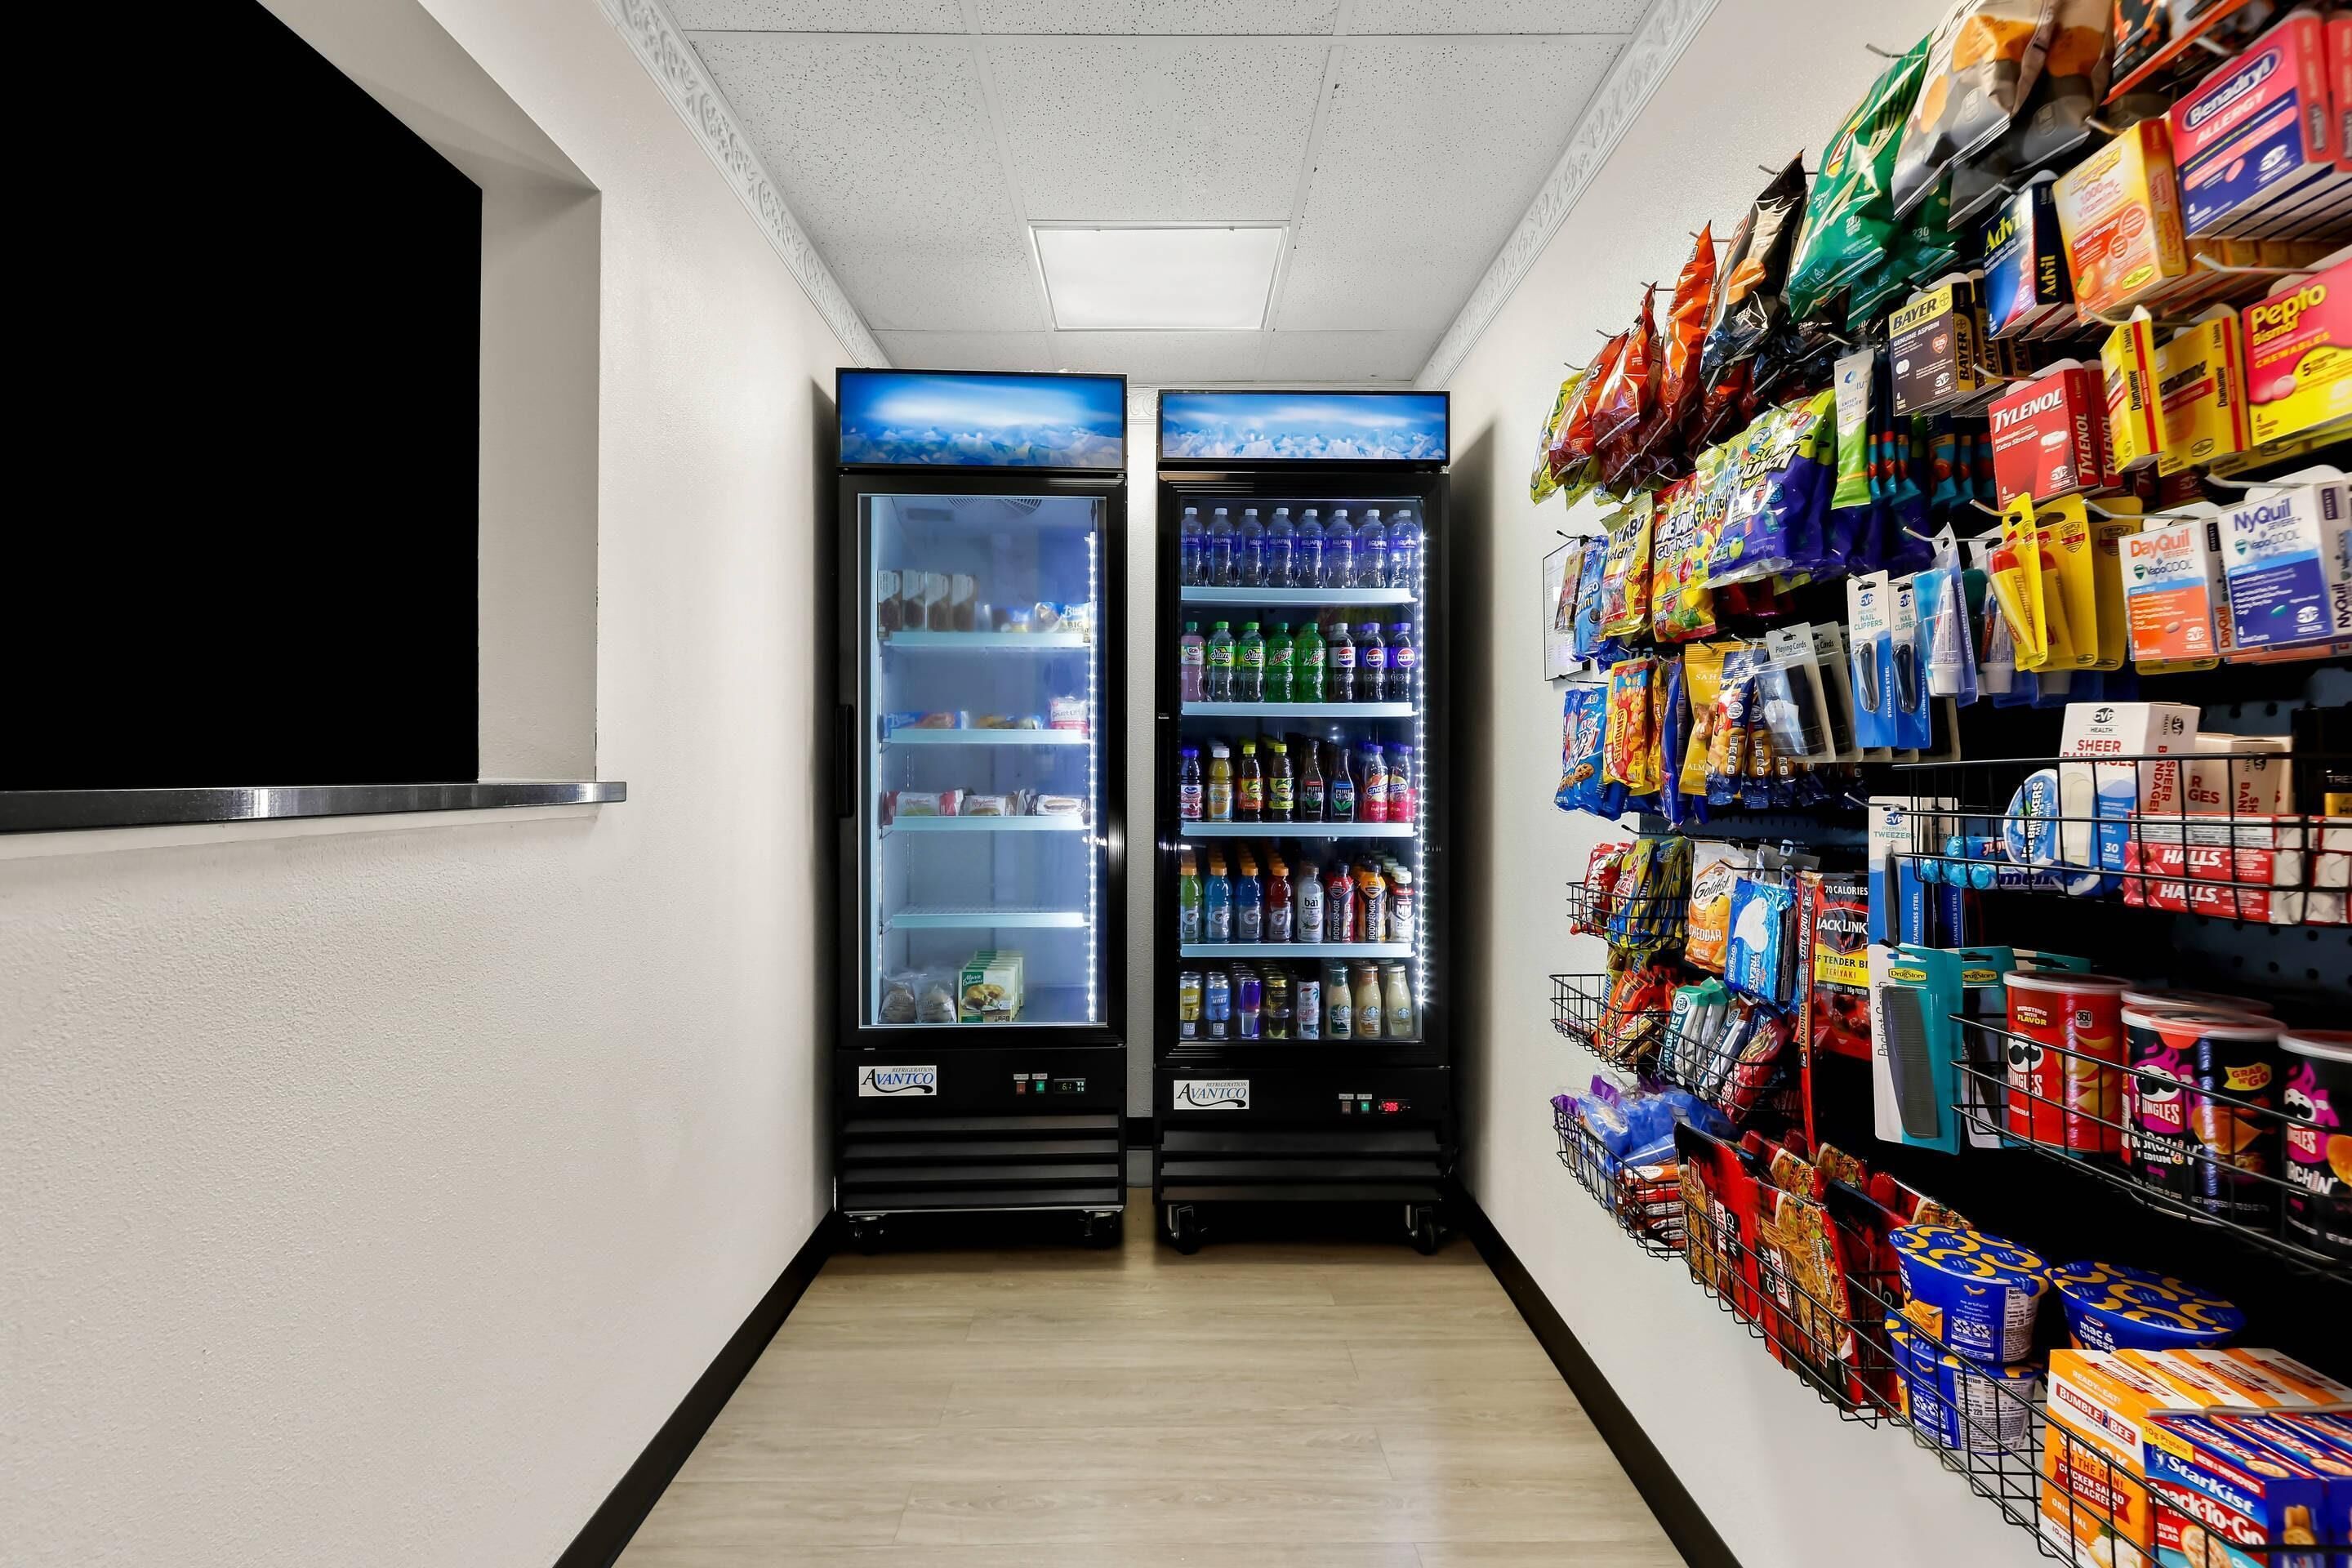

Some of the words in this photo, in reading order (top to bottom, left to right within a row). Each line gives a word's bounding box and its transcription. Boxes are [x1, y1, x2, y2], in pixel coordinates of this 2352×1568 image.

[2189, 56, 2270, 126] Benadryl
[2196, 88, 2267, 146] ALLERGY
[2074, 234, 2095, 250] Super
[2040, 256, 2057, 296] Advil
[1893, 298, 1937, 330] BAYER
[2251, 284, 2327, 332] Pepto
[1894, 331, 1918, 346] GENUINE
[1918, 321, 1940, 336] ASPIRIN
[2253, 314, 2301, 345] Bismol
[1958, 332, 1969, 380] BAYER
[2255, 332, 2332, 369] CHEWABLES
[2302, 363, 2311, 376] 5
[2129, 370, 2142, 411] Dramamine
[2216, 368, 2228, 408] Dramamine
[1993, 389, 2064, 434] TYLENOL
[1996, 440, 2013, 452] Extra
[2012, 430, 2038, 446] Strength
[2075, 414, 2096, 477] TYLENOL
[2234, 497, 2292, 533] NyQuil
[2130, 528, 2190, 559] DayQuil
[2145, 559, 2193, 577] VapoCOOL
[2332, 583, 2350, 628] NyQuil
[1855, 619, 1882, 630] CLIPPERS
[1895, 621, 1915, 630] CLIPPER
[2216, 606, 2231, 648] DayQuil
[1775, 643, 1793, 653] Playing
[1793, 641, 1806, 650] Cards
[1820, 639, 1834, 648] Cards
[1210, 648, 1232, 663] Starry
[2094, 709, 2115, 721] CVP
[2078, 739, 2121, 752] SHEER
[2160, 760, 2176, 802] SHEER
[1885, 816, 1904, 824] CVP
[2105, 842, 2118, 853] 30
[2163, 849, 2223, 867] HALLS
[1694, 875, 1731, 899] Goldfish
[1825, 885, 1833, 893] 70
[1833, 886, 1868, 895] CALORIES
[2160, 884, 2219, 903] HALLS
[1304, 898, 1319, 907] bai
[1689, 924, 1722, 942] CHEDDAR
[1816, 917, 1842, 932] JACK
[1729, 945, 1738, 983] Original
[1824, 956, 1856, 967] TENDER
[1748, 955, 1757, 991] TREATS
[1826, 967, 1856, 979] TERIYAKI
[1891, 970, 1925, 978] DrugStore
[2017, 1006, 2047, 1016] BURSTING
[2017, 1014, 2047, 1026] FLAVOR
[2077, 1012, 2091, 1021] 360
[861, 1068, 933, 1085] AVANTCO
[2232, 1065, 2262, 1079] GRAB
[1176, 1082, 1247, 1099] AVANTCO
[2136, 1150, 2172, 1165] EDIUM
[1726, 1213, 1738, 1257] CHW
[1758, 1246, 1775, 1294] CHW
[2080, 1321, 2103, 1339] mac
[2104, 1333, 2114, 1344] &
[2059, 1388, 2102, 1421] BUMBLE
[2109, 1419, 2133, 1443] BEE
[2145, 1426, 2158, 1440] 10g
[2160, 1436, 2189, 1454] Protein
[2078, 1457, 2096, 1475] THE
[2099, 1470, 2123, 1490] RN!
[2195, 1452, 2213, 1468] NEW
[2218, 1464, 2261, 1494] IMPROVED
[2168, 1456, 2255, 1515] StarKist
[2051, 1498, 2087, 1530] ORIGNAL
[2158, 1522, 2178, 1534] TUNA
